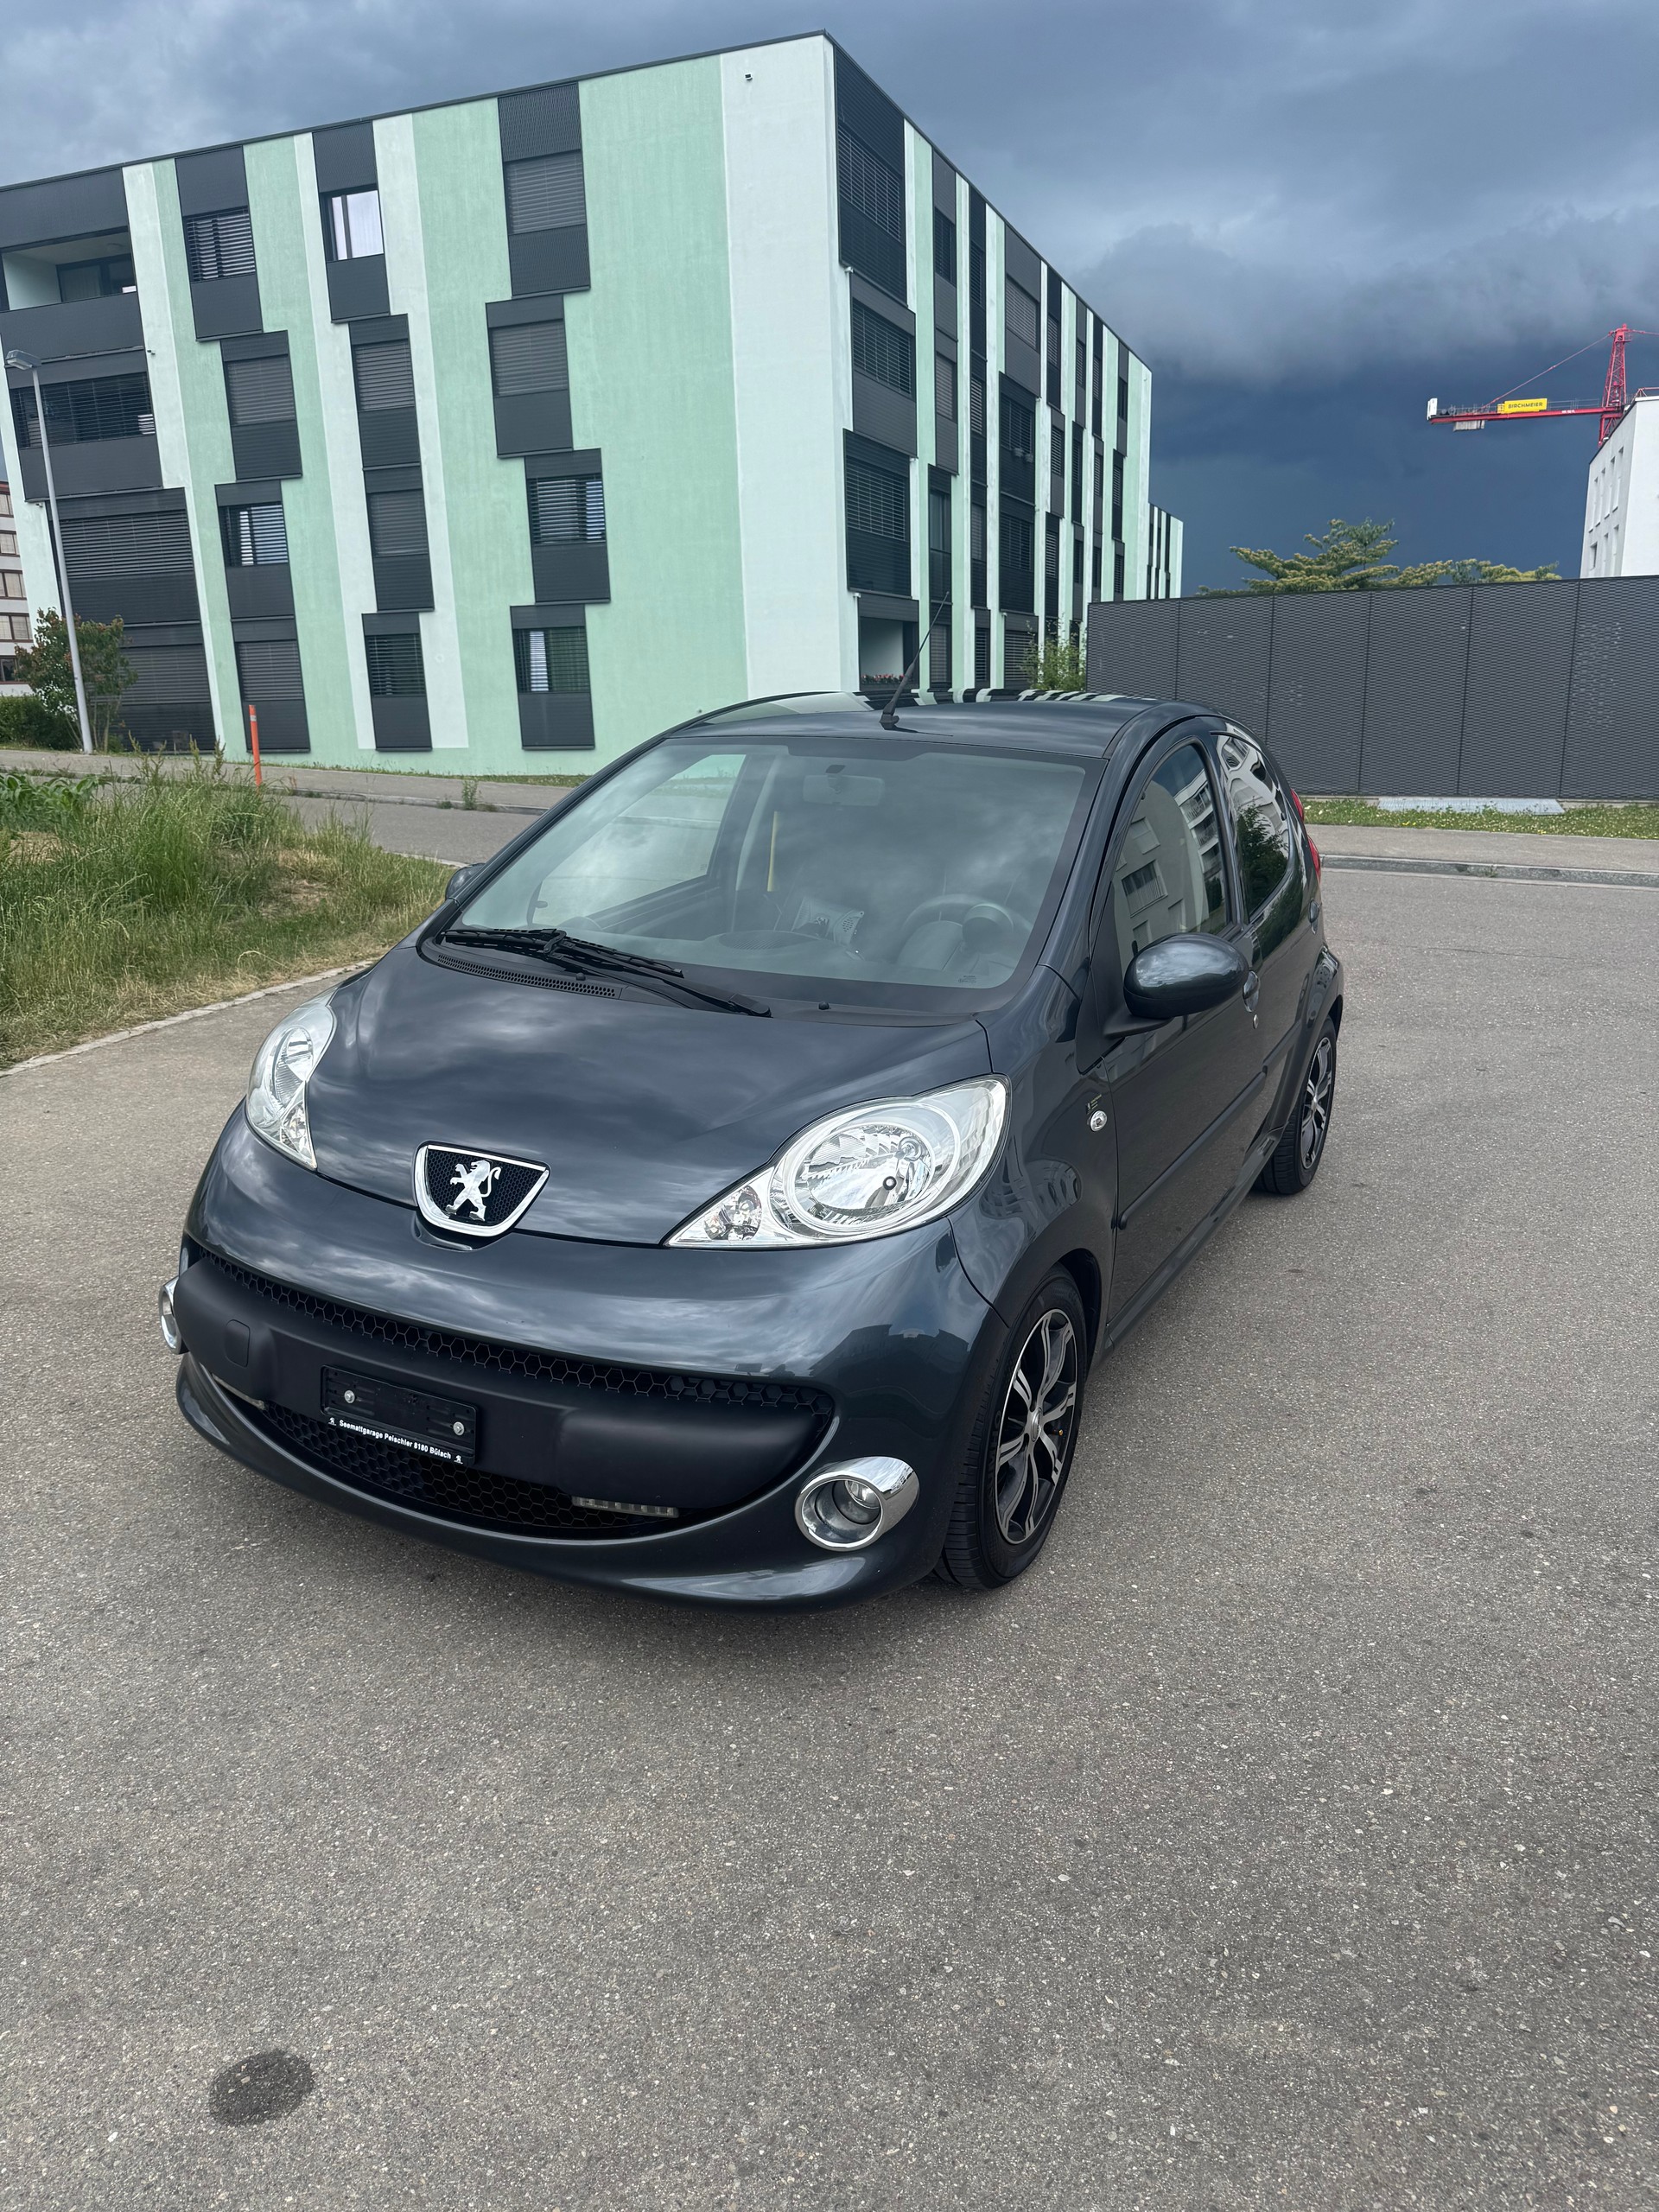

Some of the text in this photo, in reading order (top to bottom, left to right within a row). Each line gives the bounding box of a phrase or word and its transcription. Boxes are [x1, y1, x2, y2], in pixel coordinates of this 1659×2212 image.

[339, 1420, 383, 1439] Seemattgarage
[413, 1442, 429, 1452] 8180
[429, 1446, 451, 1459] Bülach
